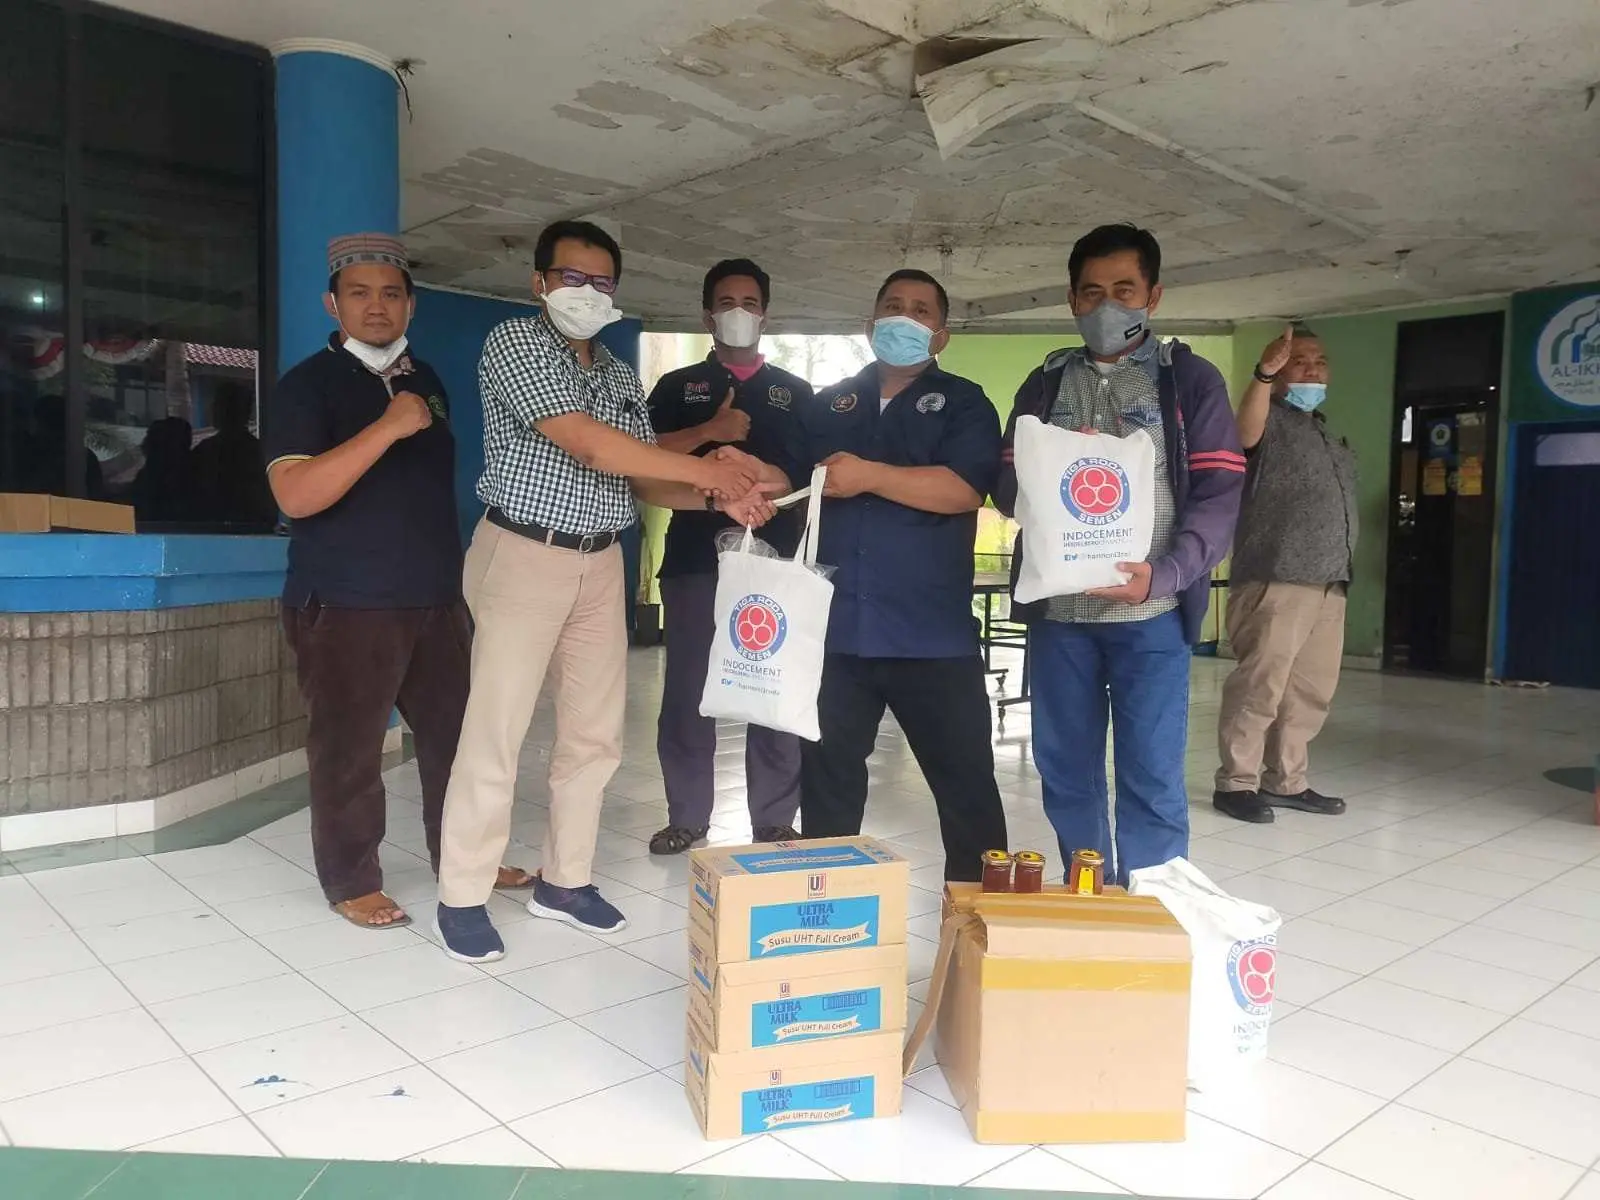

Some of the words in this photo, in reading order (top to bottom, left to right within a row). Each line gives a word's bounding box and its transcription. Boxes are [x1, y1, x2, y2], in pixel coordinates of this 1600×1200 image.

[1063, 458, 1087, 481] TIGA
[1089, 458, 1123, 476] RODA
[1078, 509, 1123, 525] SEMEN
[1063, 527, 1134, 541] INDOCEMENT
[723, 657, 782, 677] INDOCEMENT
[797, 903, 835, 916] ULTRA
[800, 914, 831, 928] MILK
[768, 934, 792, 947] Susu
[794, 933, 813, 943] UHT
[815, 933, 831, 944] Full
[833, 931, 860, 944] Cream
[768, 1000, 802, 1014] ULTRA
[770, 1012, 799, 1025] MILK
[782, 1025, 800, 1035] Susu
[802, 1023, 816, 1032] UHT
[818, 1023, 831, 1032] Full
[832, 1020, 853, 1030] Cream
[758, 1087, 793, 1101] ULTRA
[761, 1098, 790, 1113] MILK
[773, 1113, 791, 1123] Susu
[793, 1111, 808, 1120] UHT
[810, 1110, 823, 1119] Full
[824, 1108, 846, 1118] Cream
